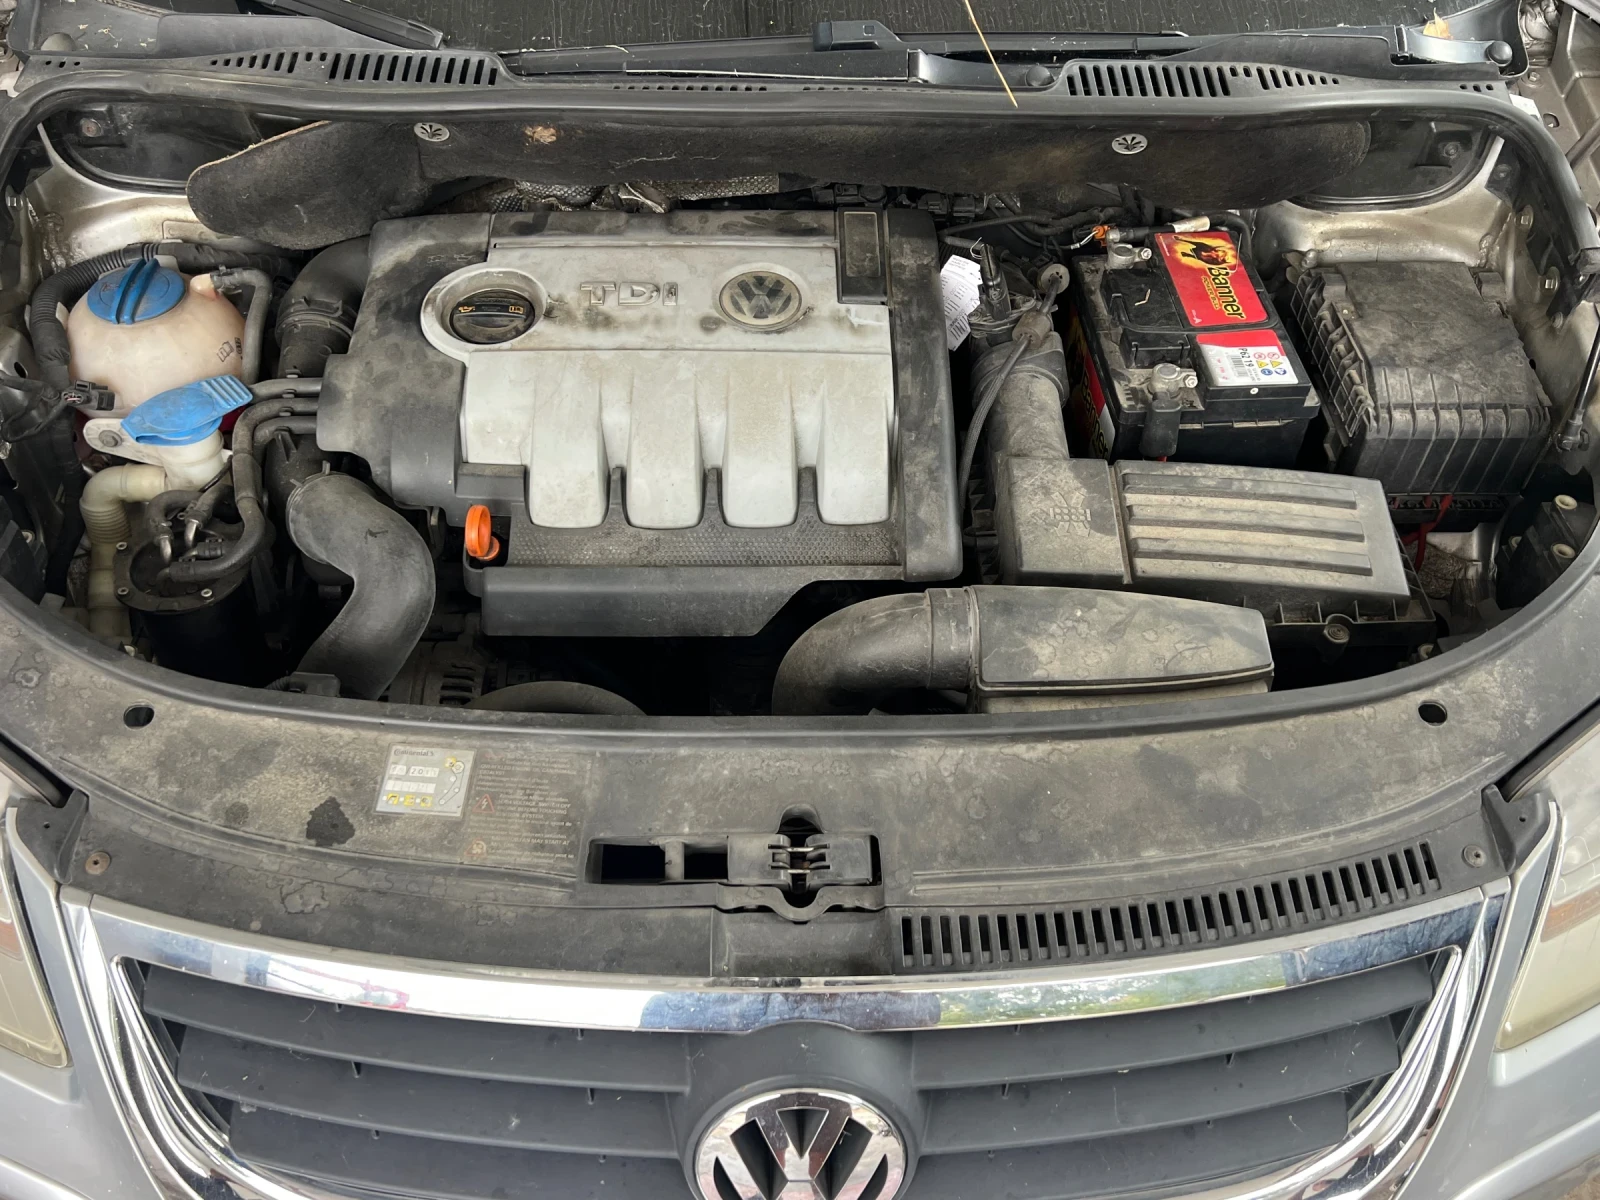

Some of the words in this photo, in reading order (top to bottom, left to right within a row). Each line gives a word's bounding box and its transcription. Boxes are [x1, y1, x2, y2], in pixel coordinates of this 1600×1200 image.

[580, 281, 679, 306] TDI
[1207, 266, 1246, 319] Banner
[1238, 347, 1251, 359] P62
[1243, 359, 1255, 368] 19
[393, 748, 430, 757] Continental
